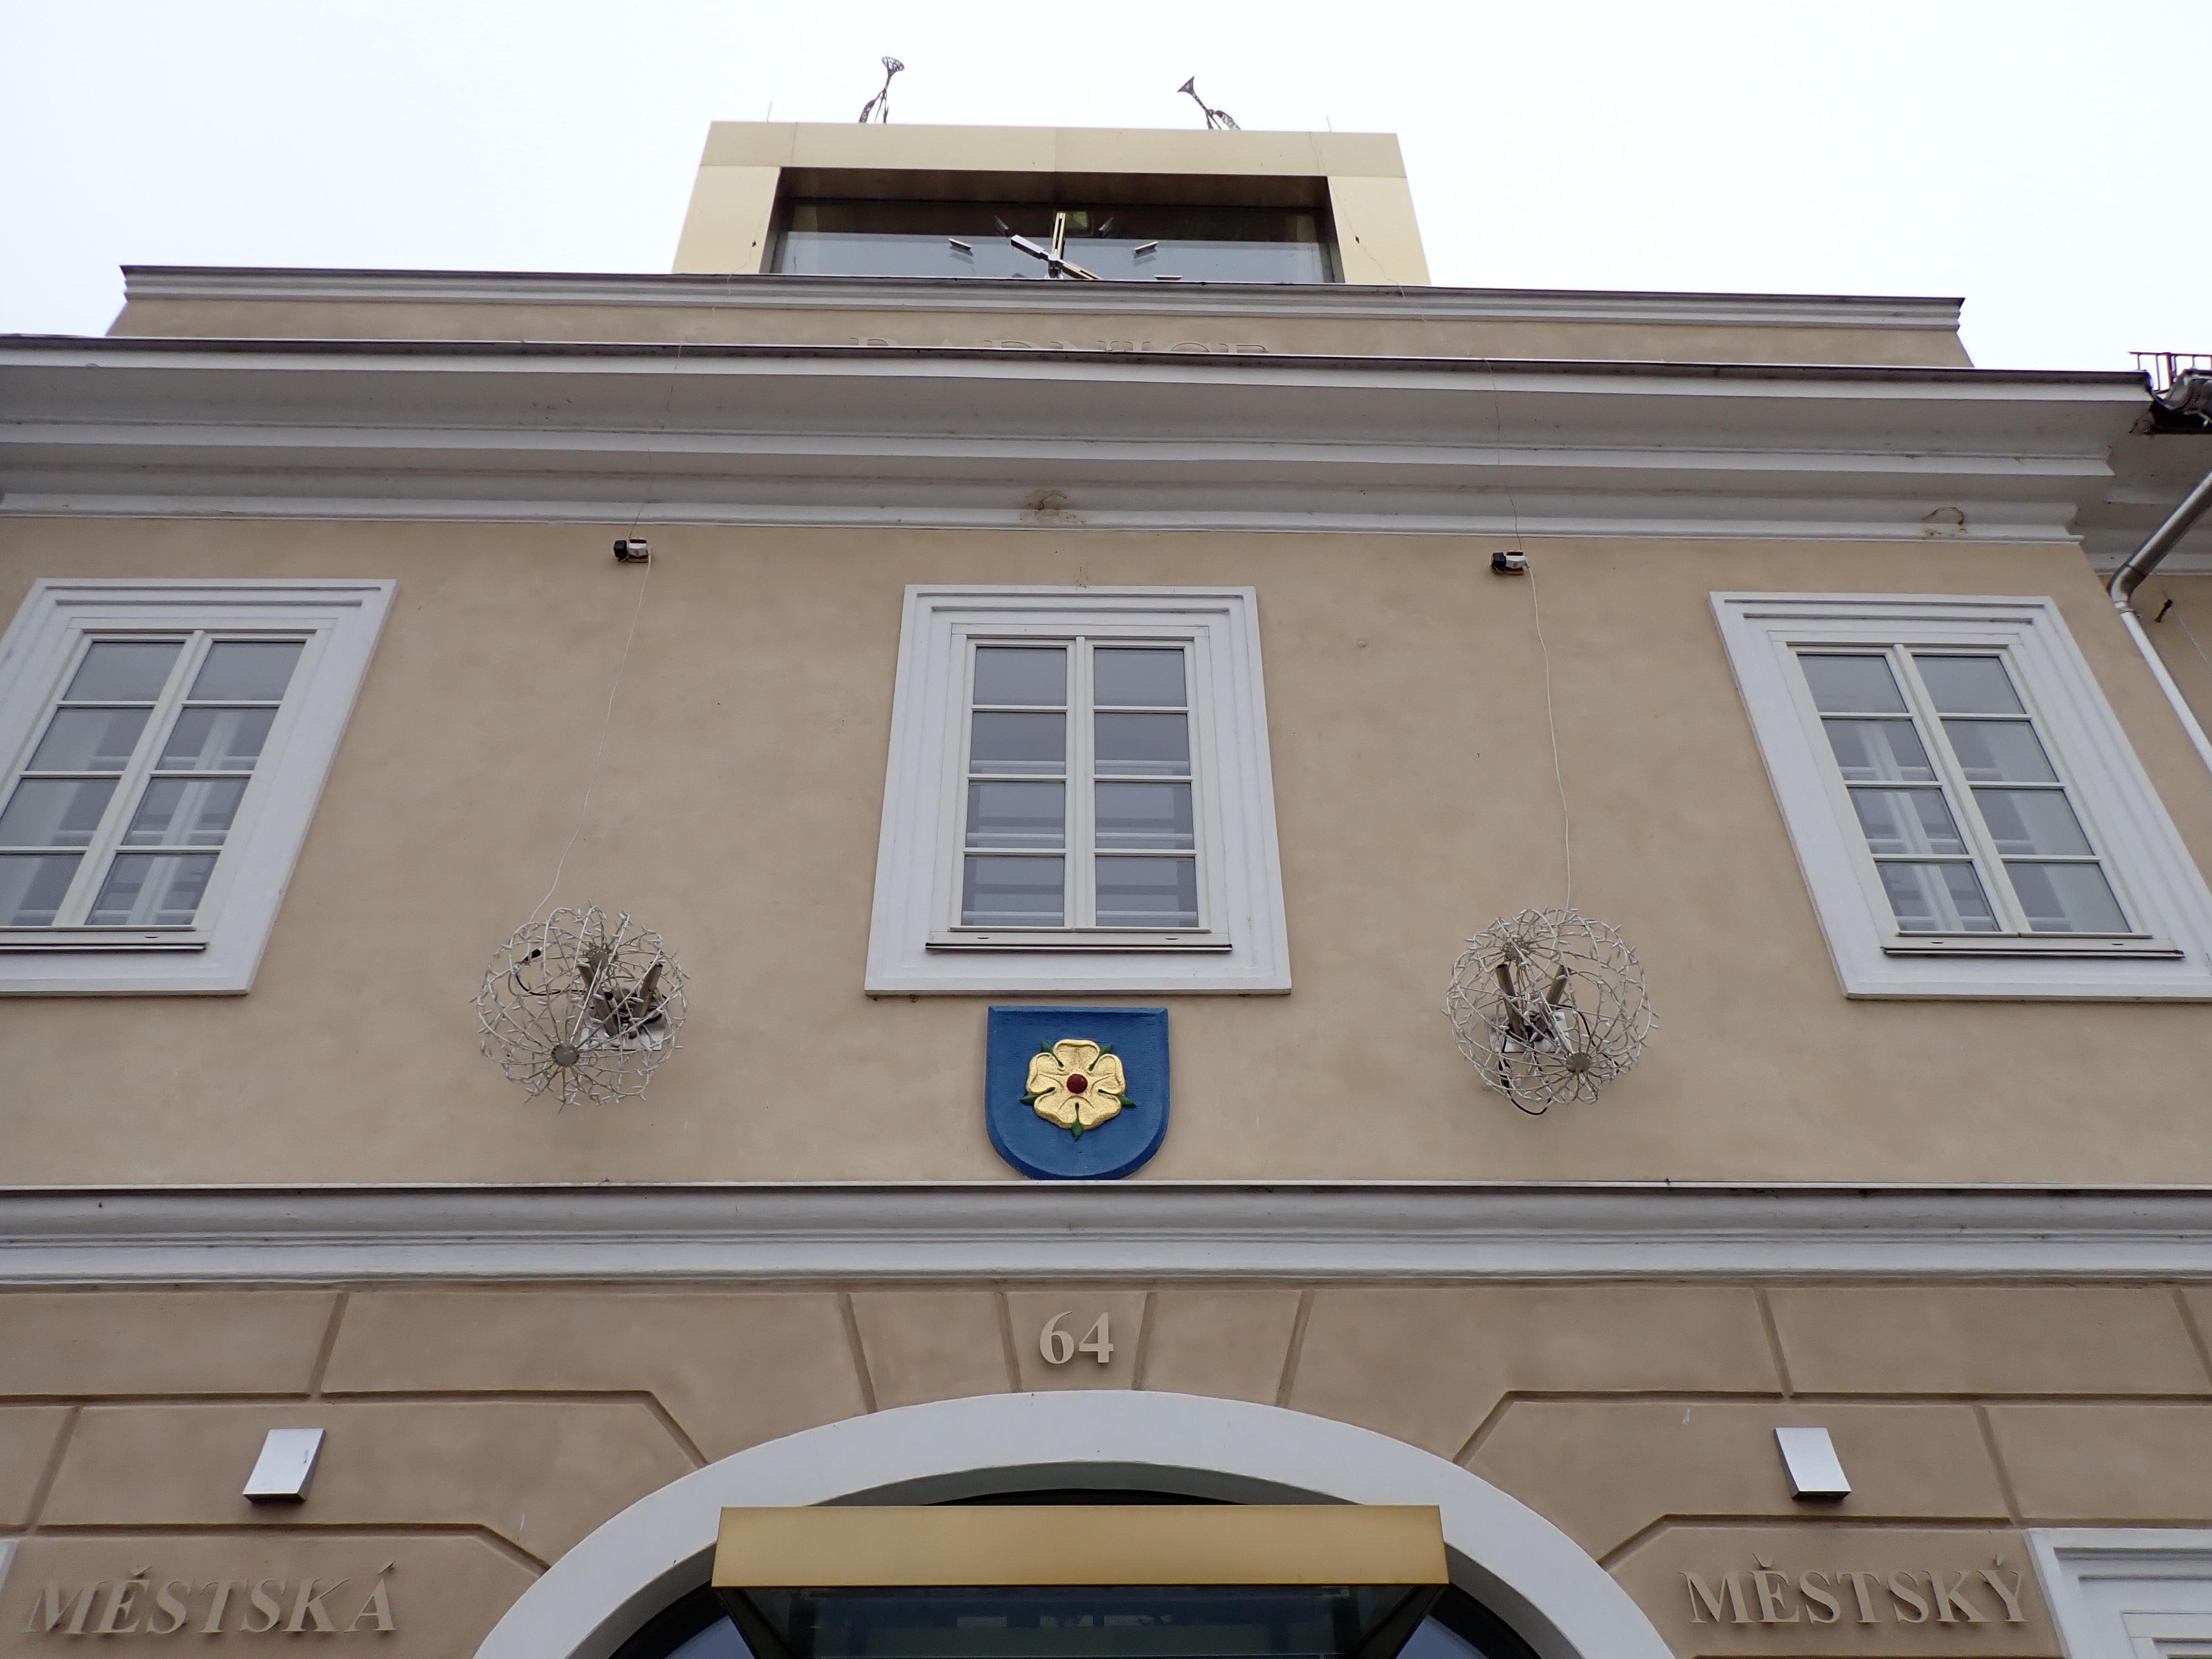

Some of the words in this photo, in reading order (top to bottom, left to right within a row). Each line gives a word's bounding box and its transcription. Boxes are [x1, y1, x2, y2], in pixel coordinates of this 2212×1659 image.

[1040, 1311, 1114, 1364] 64
[21, 1561, 397, 1634] MĚSTSKÁ
[1678, 1553, 2030, 1624] MĚSTSKÝ
